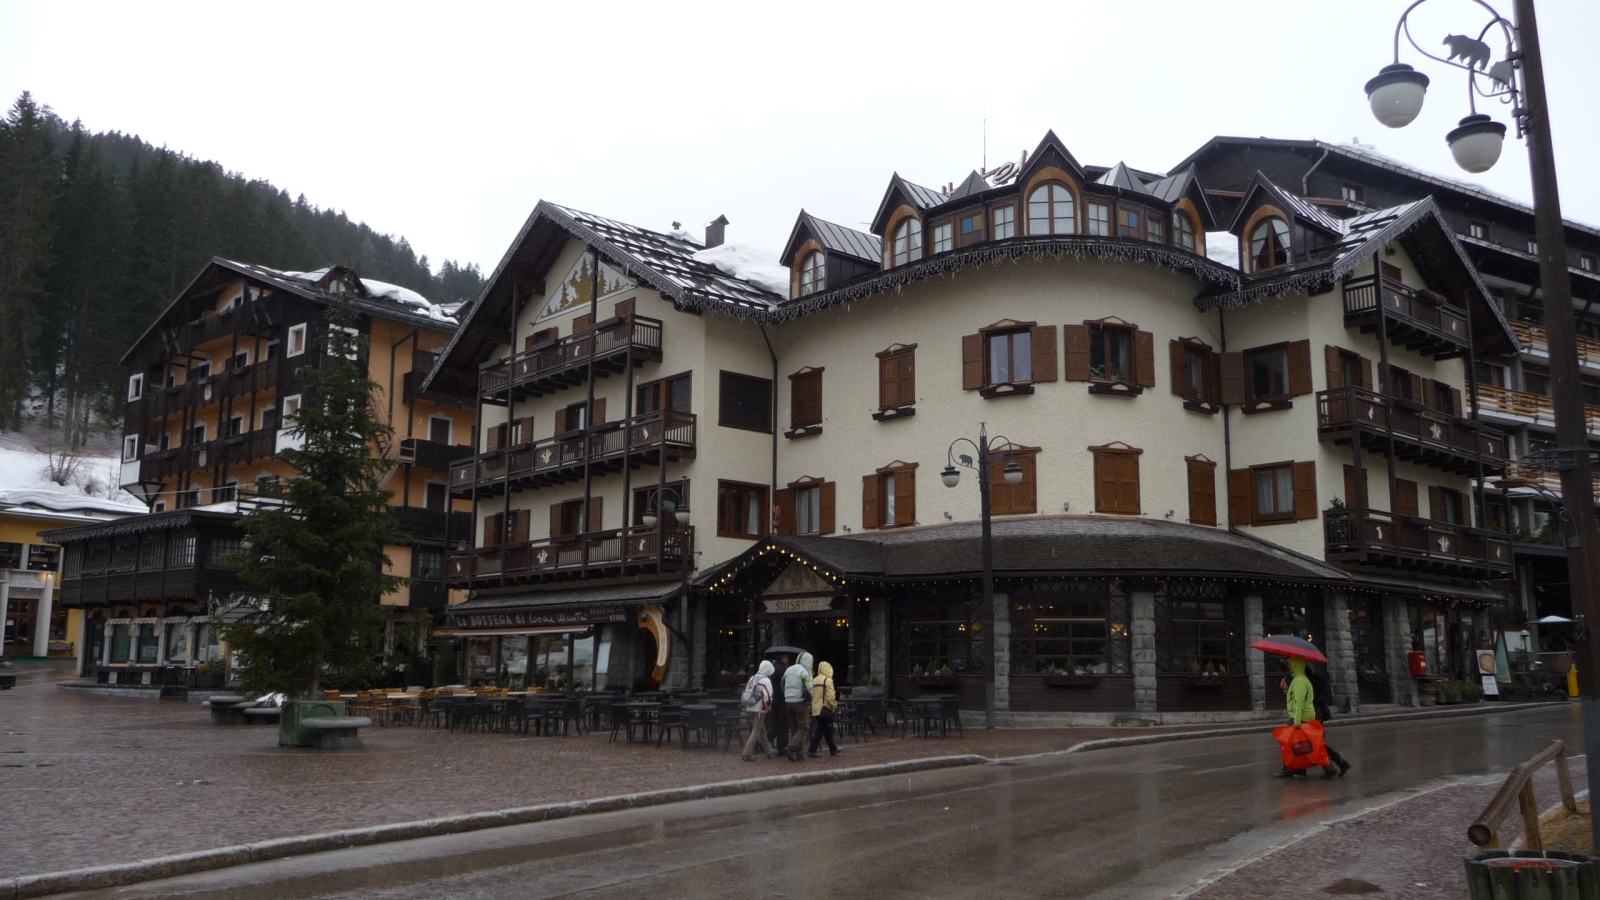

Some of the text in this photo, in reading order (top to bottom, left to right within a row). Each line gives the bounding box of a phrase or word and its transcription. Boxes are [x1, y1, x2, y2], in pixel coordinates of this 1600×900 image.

[470, 614, 513, 627] BOTTEGA
[515, 614, 525, 624] di
[609, 614, 626, 622] STORE
